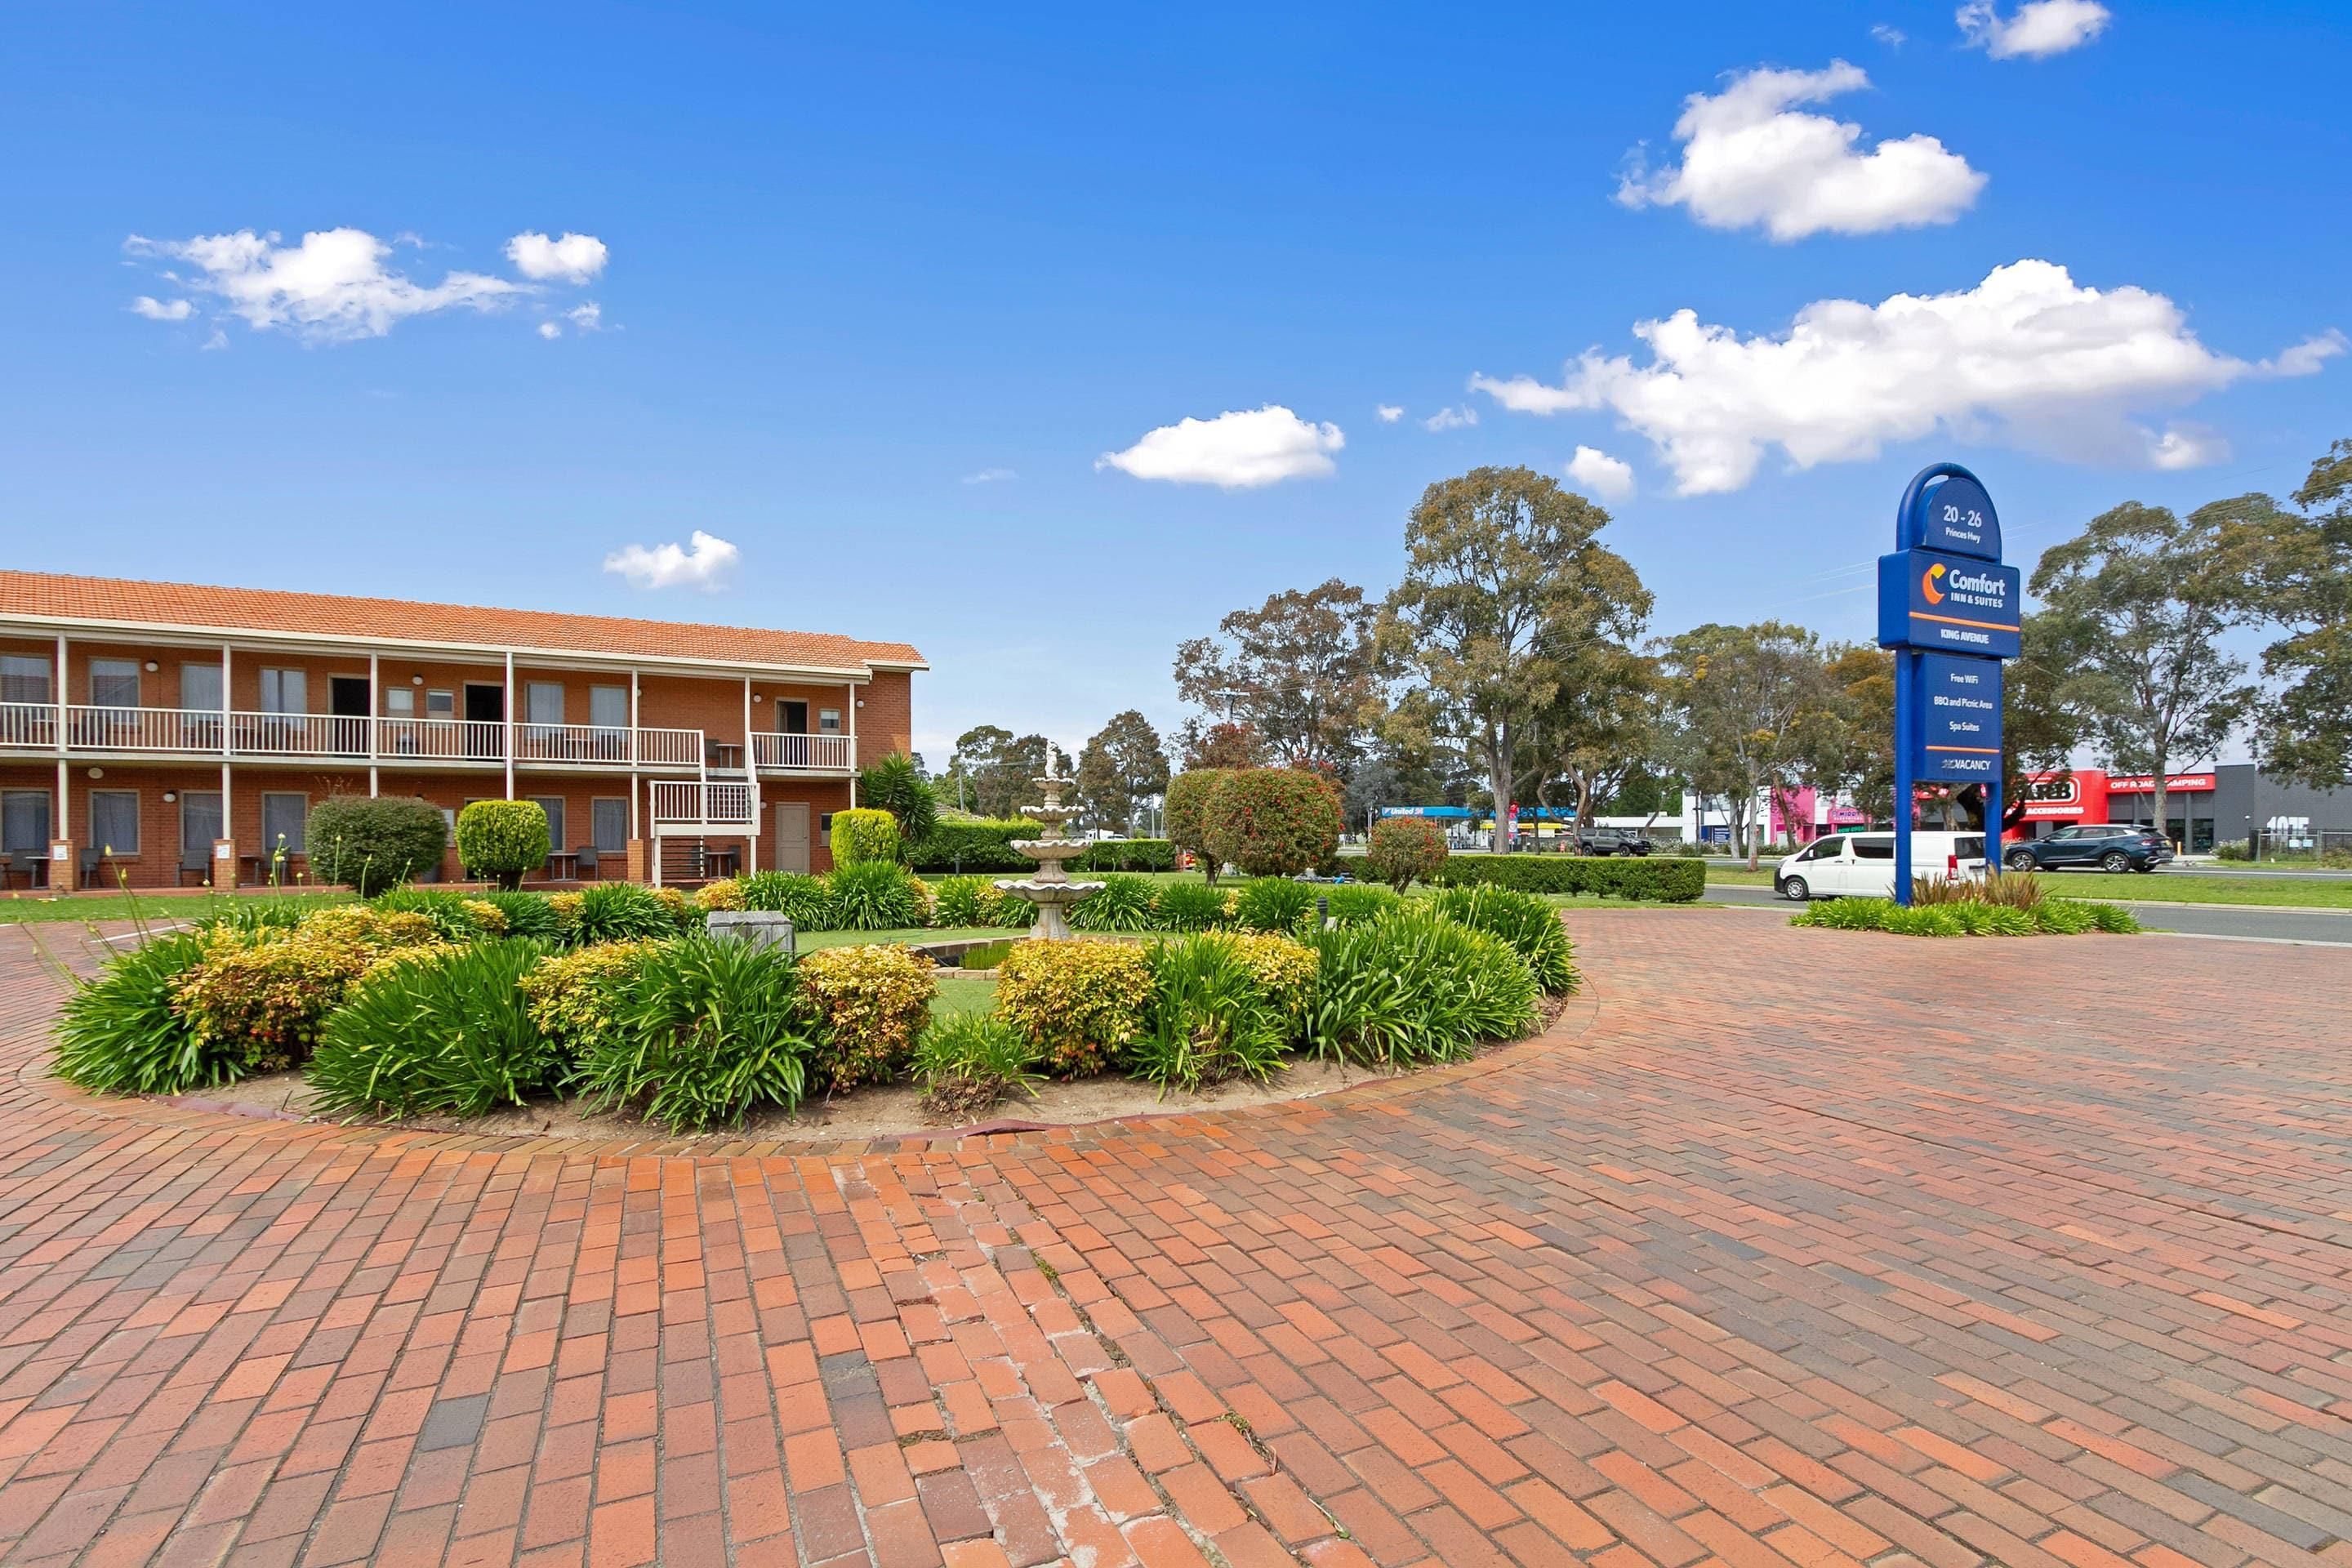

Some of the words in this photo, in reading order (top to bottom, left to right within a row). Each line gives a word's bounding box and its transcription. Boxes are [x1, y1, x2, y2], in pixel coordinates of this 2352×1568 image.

[1944, 505, 1958, 523] 20
[1967, 510, 1982, 528] 26
[1945, 527, 1967, 539] Princes
[1967, 531, 1981, 544] Hwy
[1949, 569, 2005, 596] Comfort
[1951, 592, 1967, 603] INN
[1967, 595, 1974, 604] &
[1975, 595, 2003, 608] SUITES
[1940, 628, 1959, 640] KING
[1960, 631, 1989, 644] AVENUE
[1950, 673, 1964, 684] Free
[1965, 675, 1978, 684] WiFi
[1934, 696, 1949, 706] BBQ
[1949, 697, 1961, 706] and
[1962, 698, 1979, 708] Picnic
[1980, 700, 1993, 709] Area
[1949, 721, 1961, 732] Spa
[1962, 722, 1980, 732] Suites
[1955, 760, 1991, 770] VACANCY
[2164, 778, 2206, 787] AMPING
